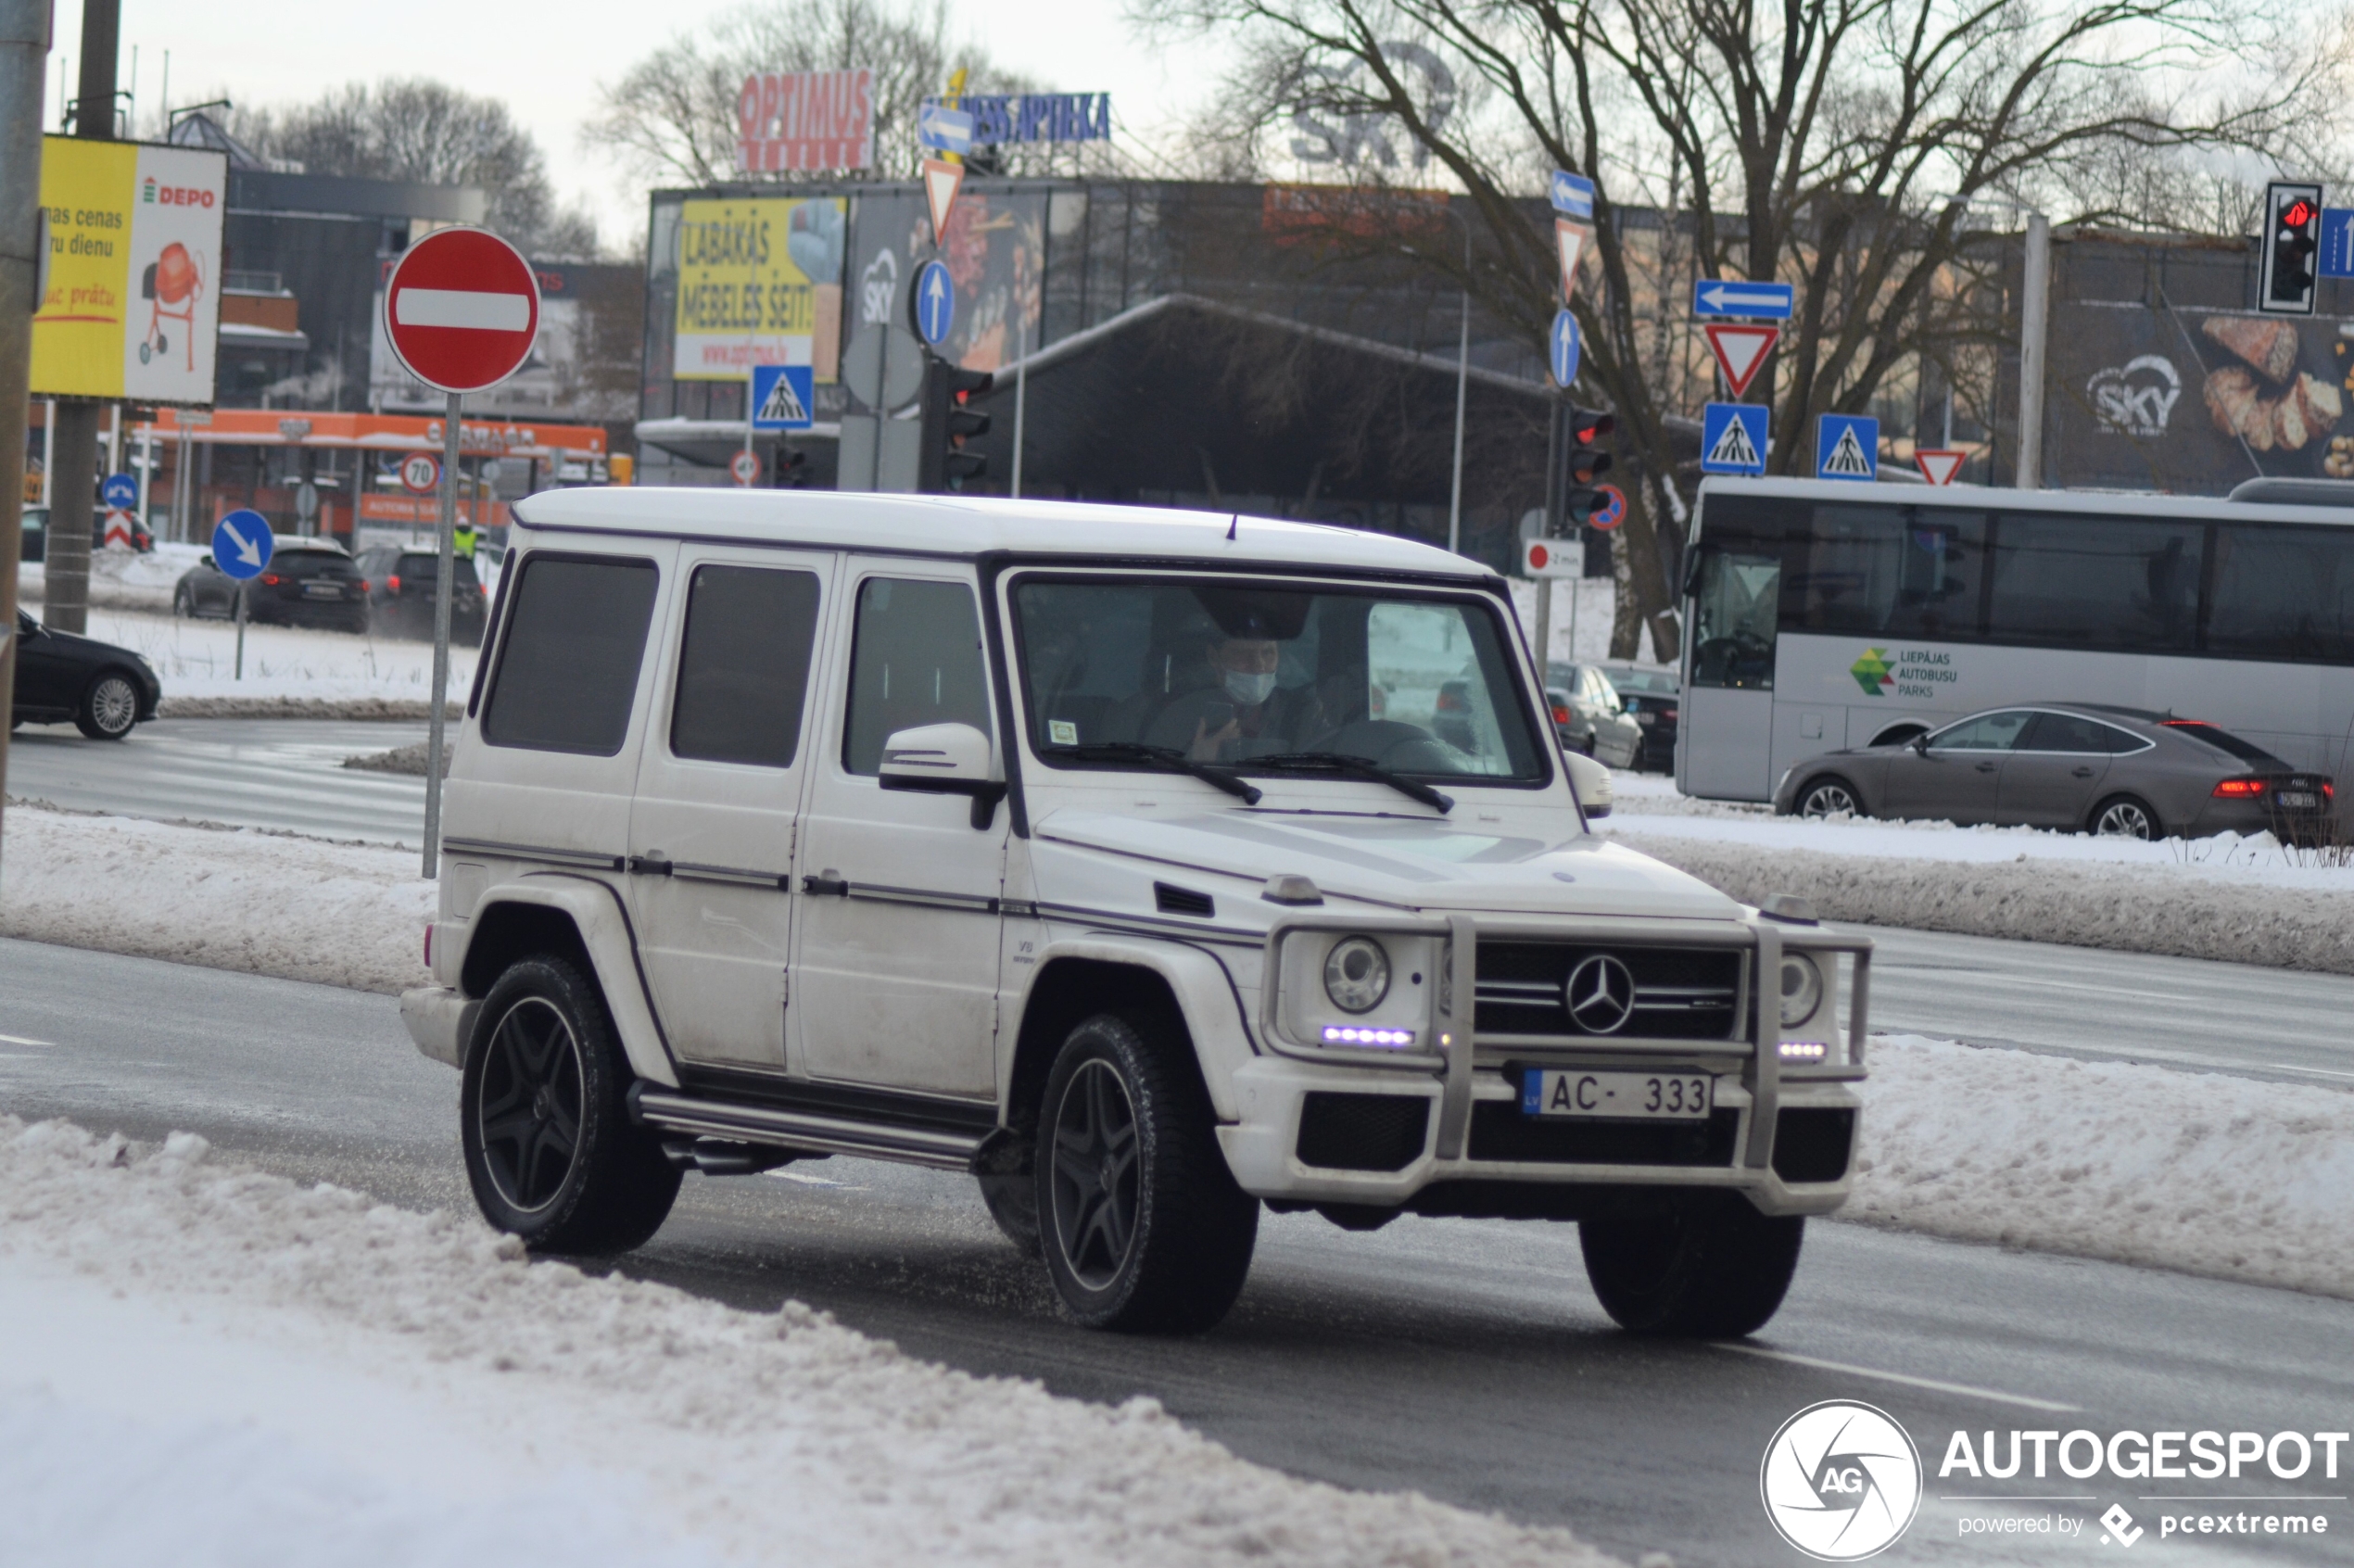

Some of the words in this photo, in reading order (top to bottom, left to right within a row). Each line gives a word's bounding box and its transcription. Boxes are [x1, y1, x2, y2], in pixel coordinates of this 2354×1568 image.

[740, 70, 869, 139] OPTIMUS
[1017, 93, 1111, 142] APTIEKA
[159, 186, 214, 209] DEPO
[76, 209, 122, 229] cenas
[70, 234, 113, 257] dienu
[686, 209, 769, 266] LABĀKĀS
[681, 271, 763, 330] MĒBELES
[768, 269, 813, 329] ŠEIT!
[863, 280, 896, 324] SKY
[2095, 384, 2182, 427] SKY
[411, 462, 430, 483] 70
[1900, 651, 1950, 665] LIEPĀJAS
[1899, 668, 1957, 683] AUTOBUSU
[1898, 685, 1933, 698] PARKS
[1525, 1095, 1538, 1106] LV
[1645, 1078, 1704, 1113] 333
